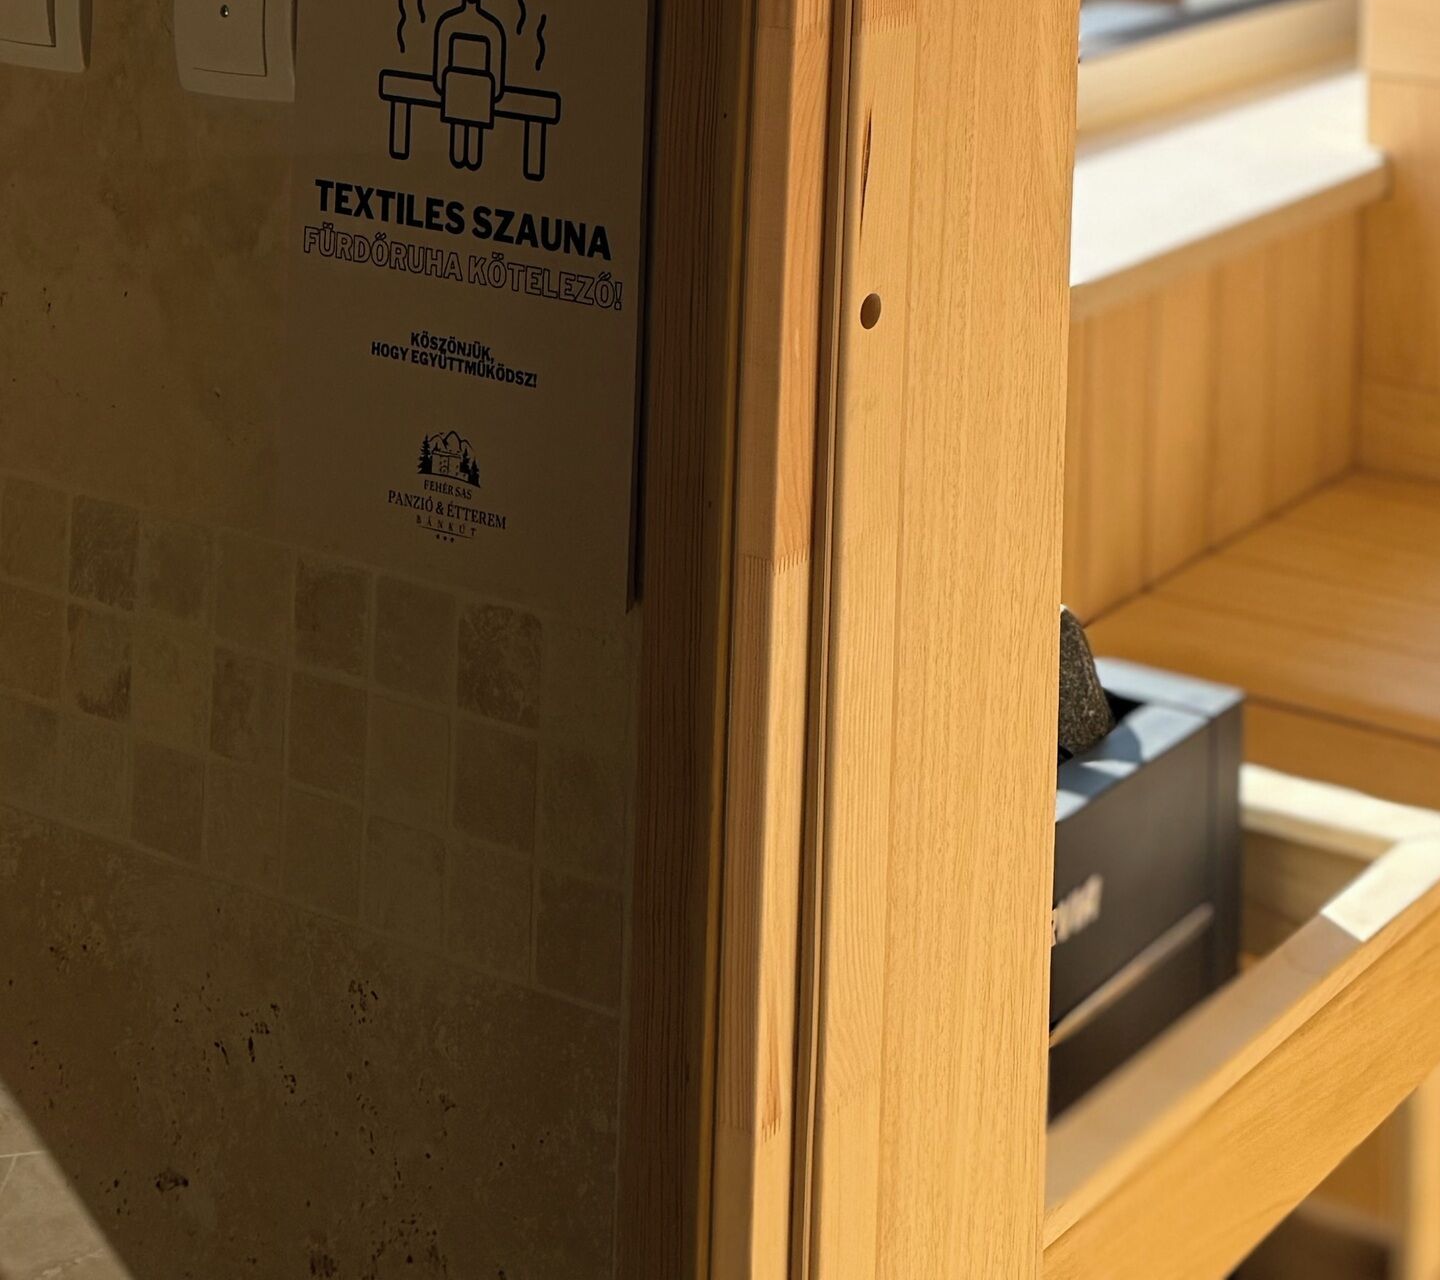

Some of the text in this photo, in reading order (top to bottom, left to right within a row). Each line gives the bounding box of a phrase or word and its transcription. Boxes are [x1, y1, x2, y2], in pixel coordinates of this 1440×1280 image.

[315, 179, 612, 261] TEXTILES SZAUNA
[303, 222, 623, 311] FÜRDŐRUHA KÖTELEZŐ!
[371, 341, 409, 362] HOGY
[411, 330, 495, 364] KÖSZÖNJÜK,
[423, 479, 472, 500] FEHÉR SAS
[388, 489, 507, 531] PANZIÓ & ÉTTEREM
